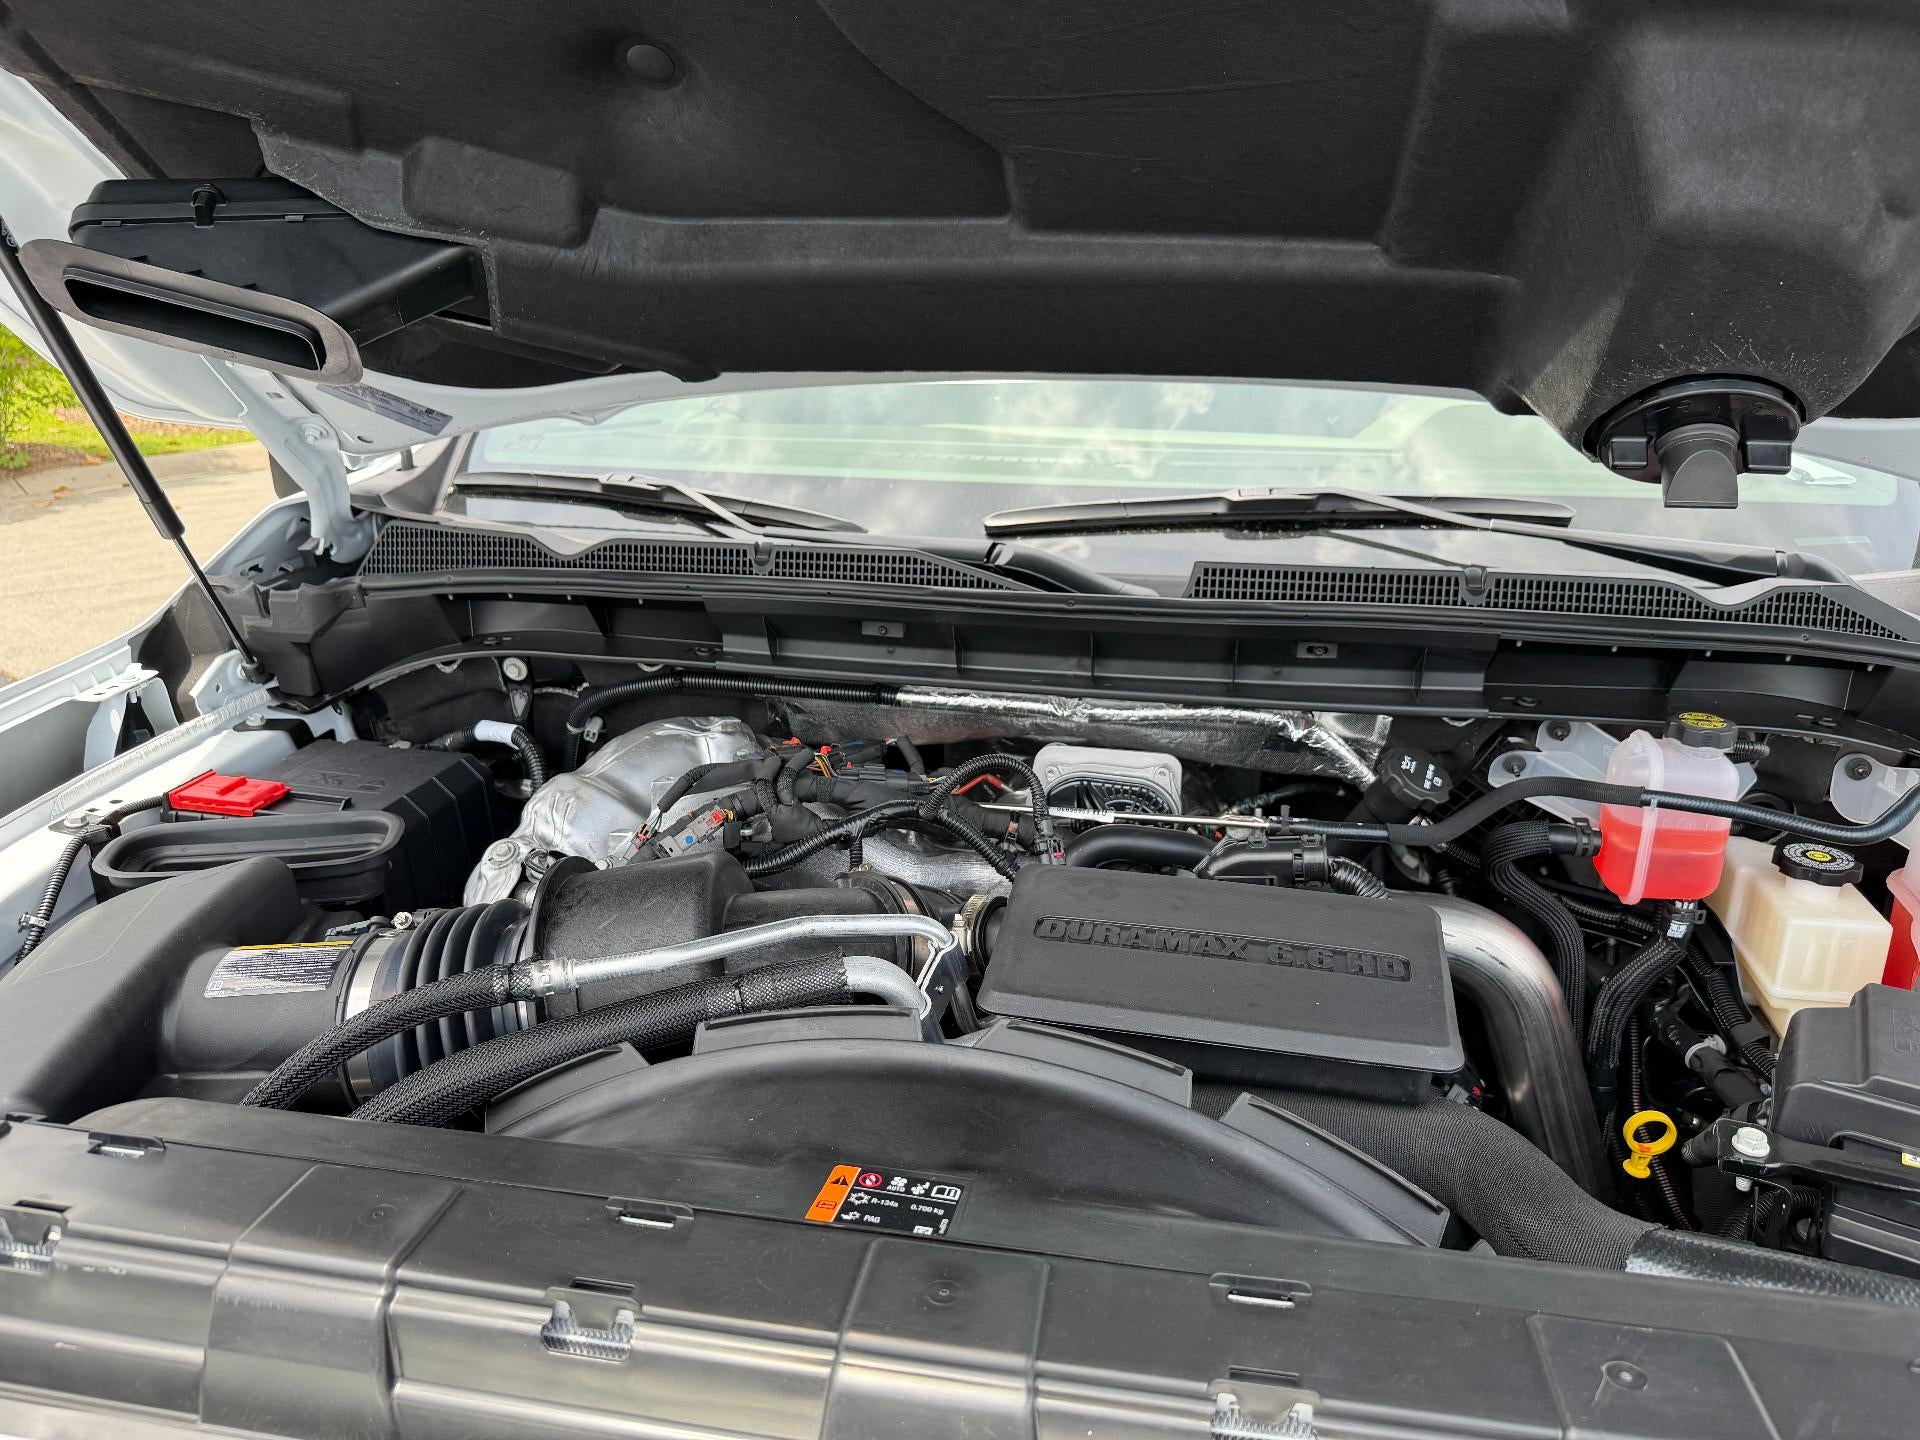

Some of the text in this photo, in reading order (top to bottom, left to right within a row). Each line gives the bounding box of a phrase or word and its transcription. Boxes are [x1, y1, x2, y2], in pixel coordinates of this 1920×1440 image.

[1038, 919, 1407, 980] DURAMAX 6.6 HD
[870, 1198, 899, 1207] R-134a
[863, 1214, 881, 1224] PAG
